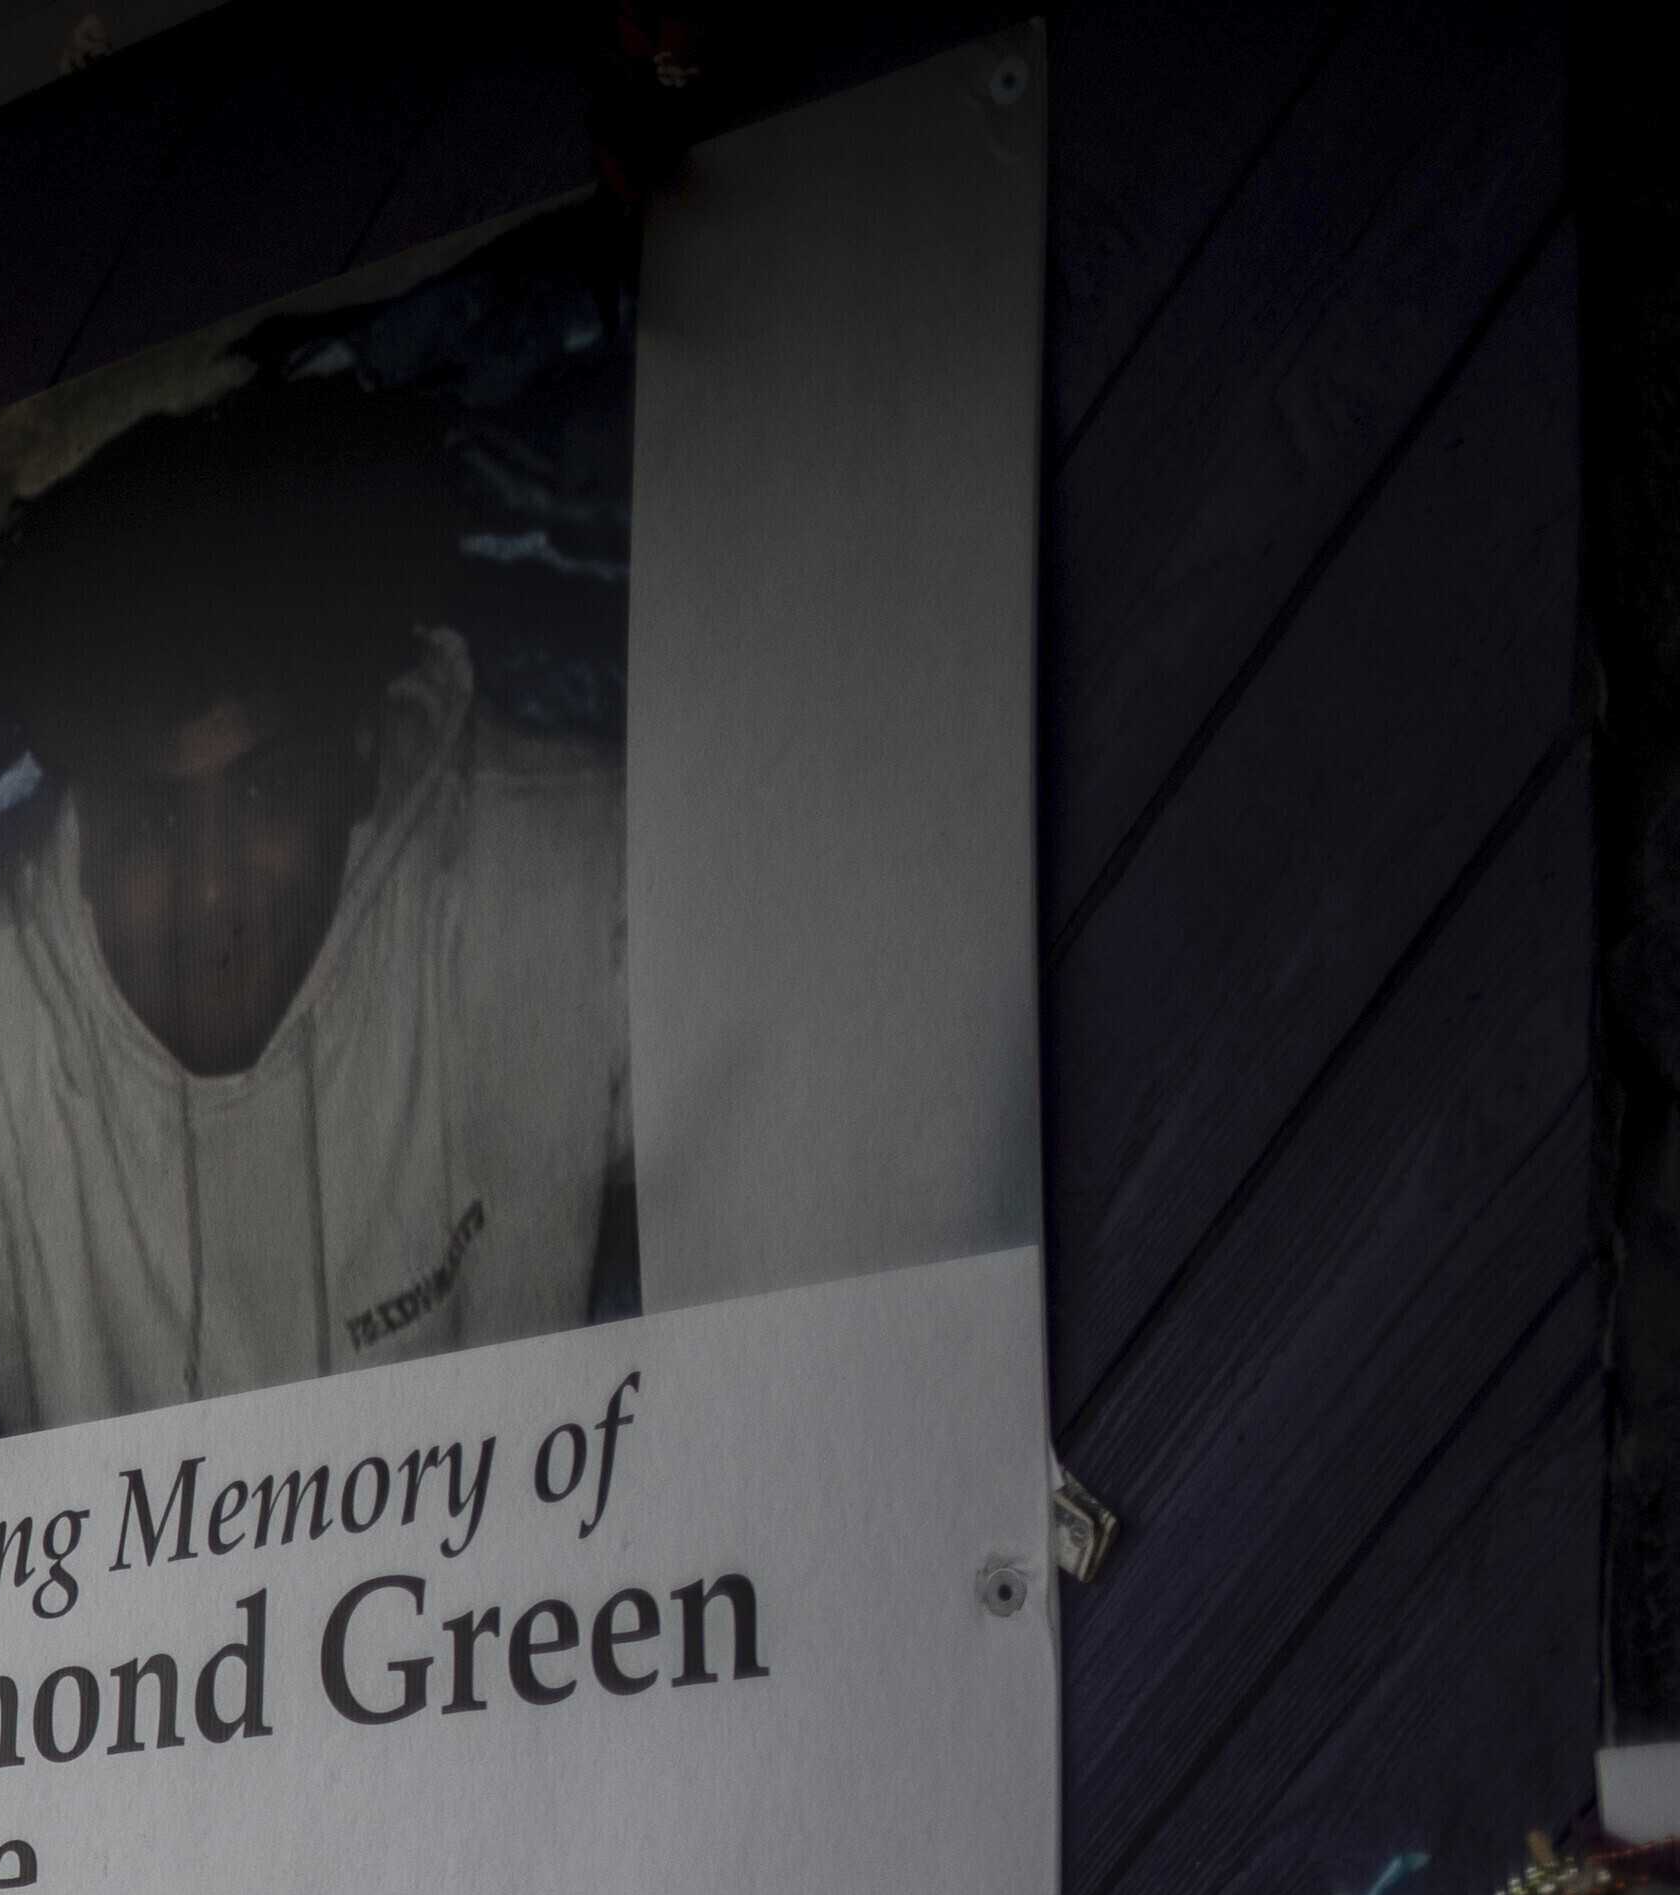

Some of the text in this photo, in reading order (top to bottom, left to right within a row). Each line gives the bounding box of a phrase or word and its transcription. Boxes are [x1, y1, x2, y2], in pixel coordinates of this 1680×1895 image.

[109, 1436, 497, 1572] Memory
[534, 1370, 641, 1539] of
[320, 1572, 770, 1725] Green
